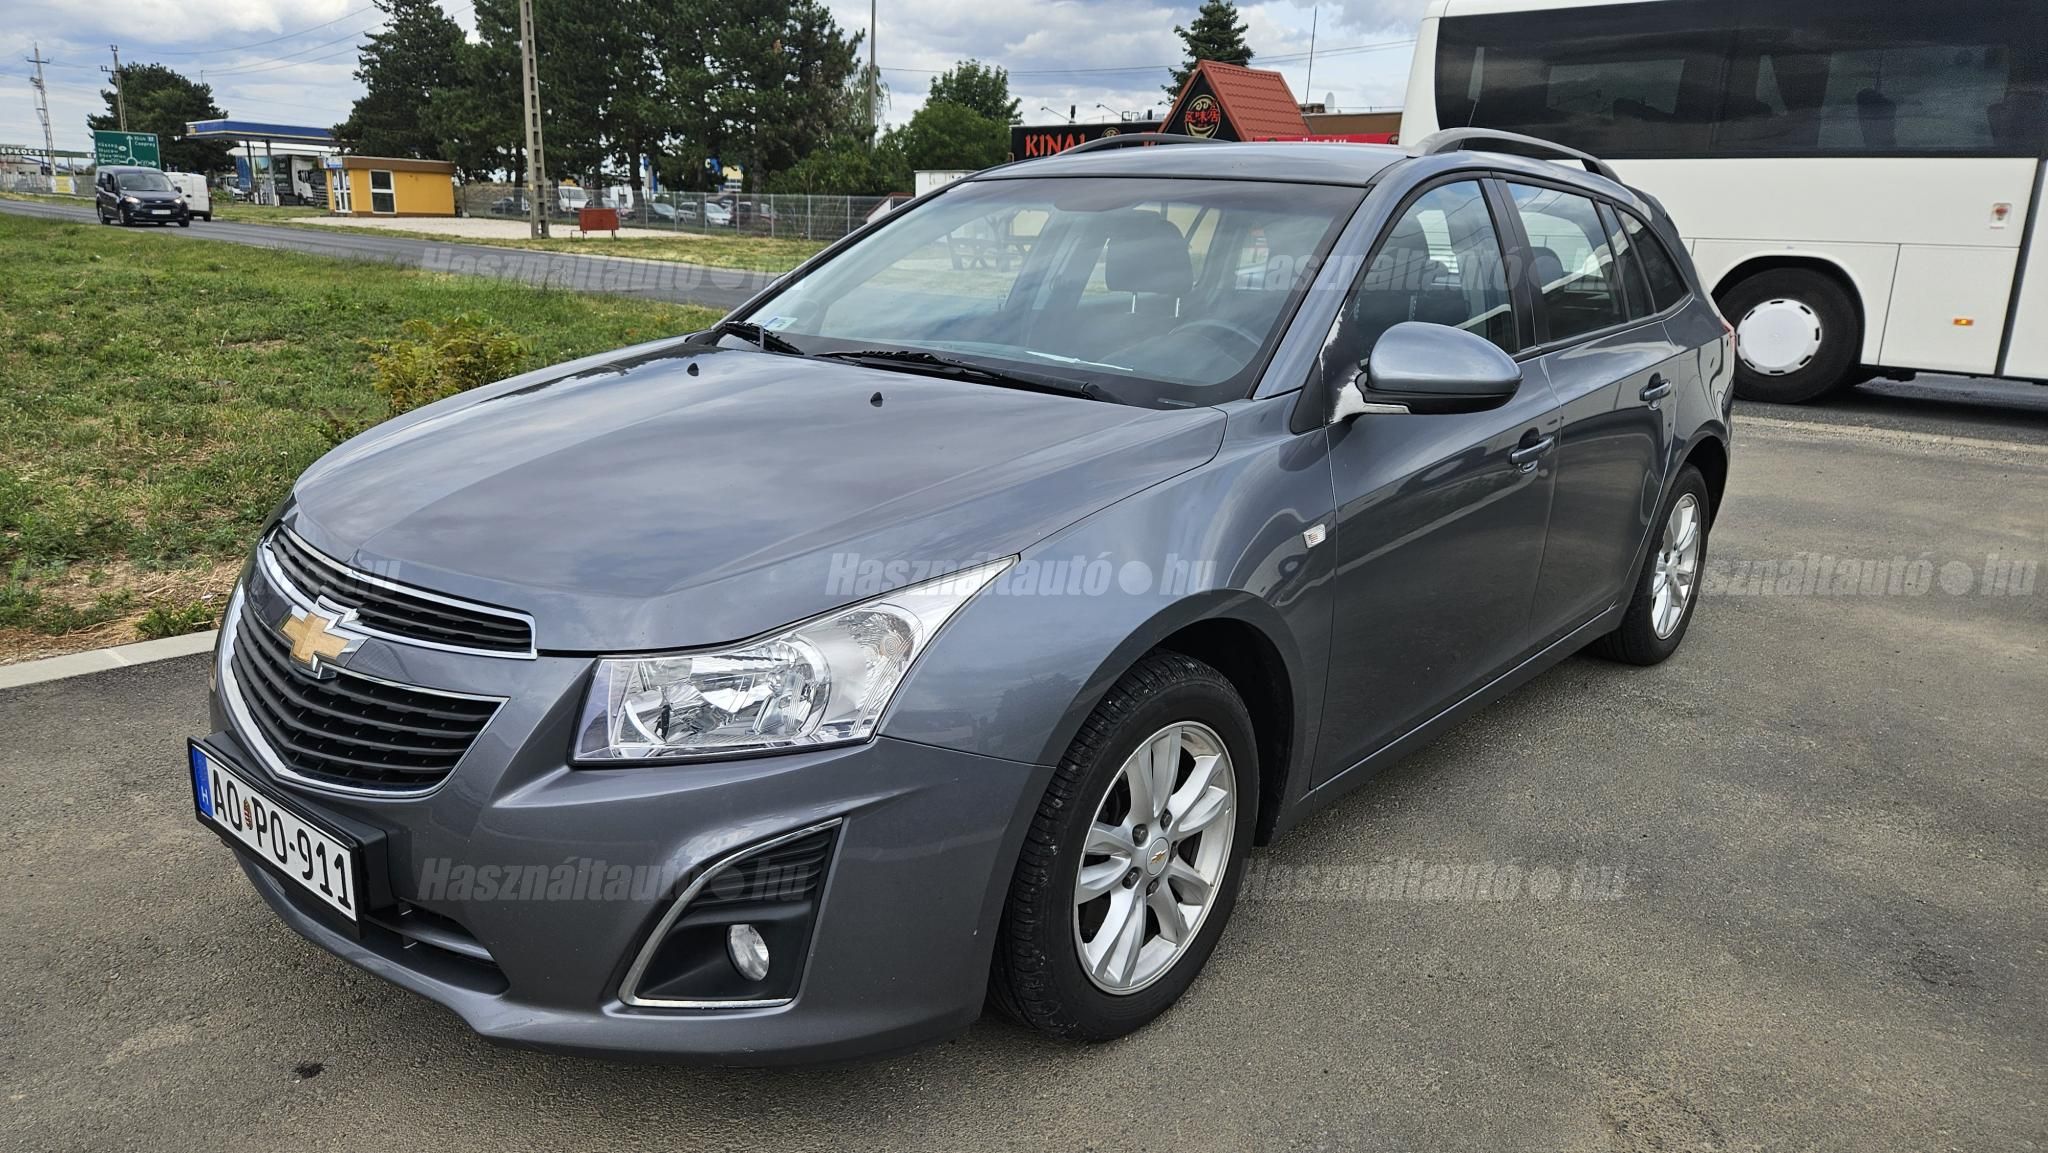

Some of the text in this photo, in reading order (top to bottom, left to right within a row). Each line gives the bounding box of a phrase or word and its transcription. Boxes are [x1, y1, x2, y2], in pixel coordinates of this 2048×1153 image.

[201, 786, 210, 805] H
[213, 769, 352, 910] AO PO-911
